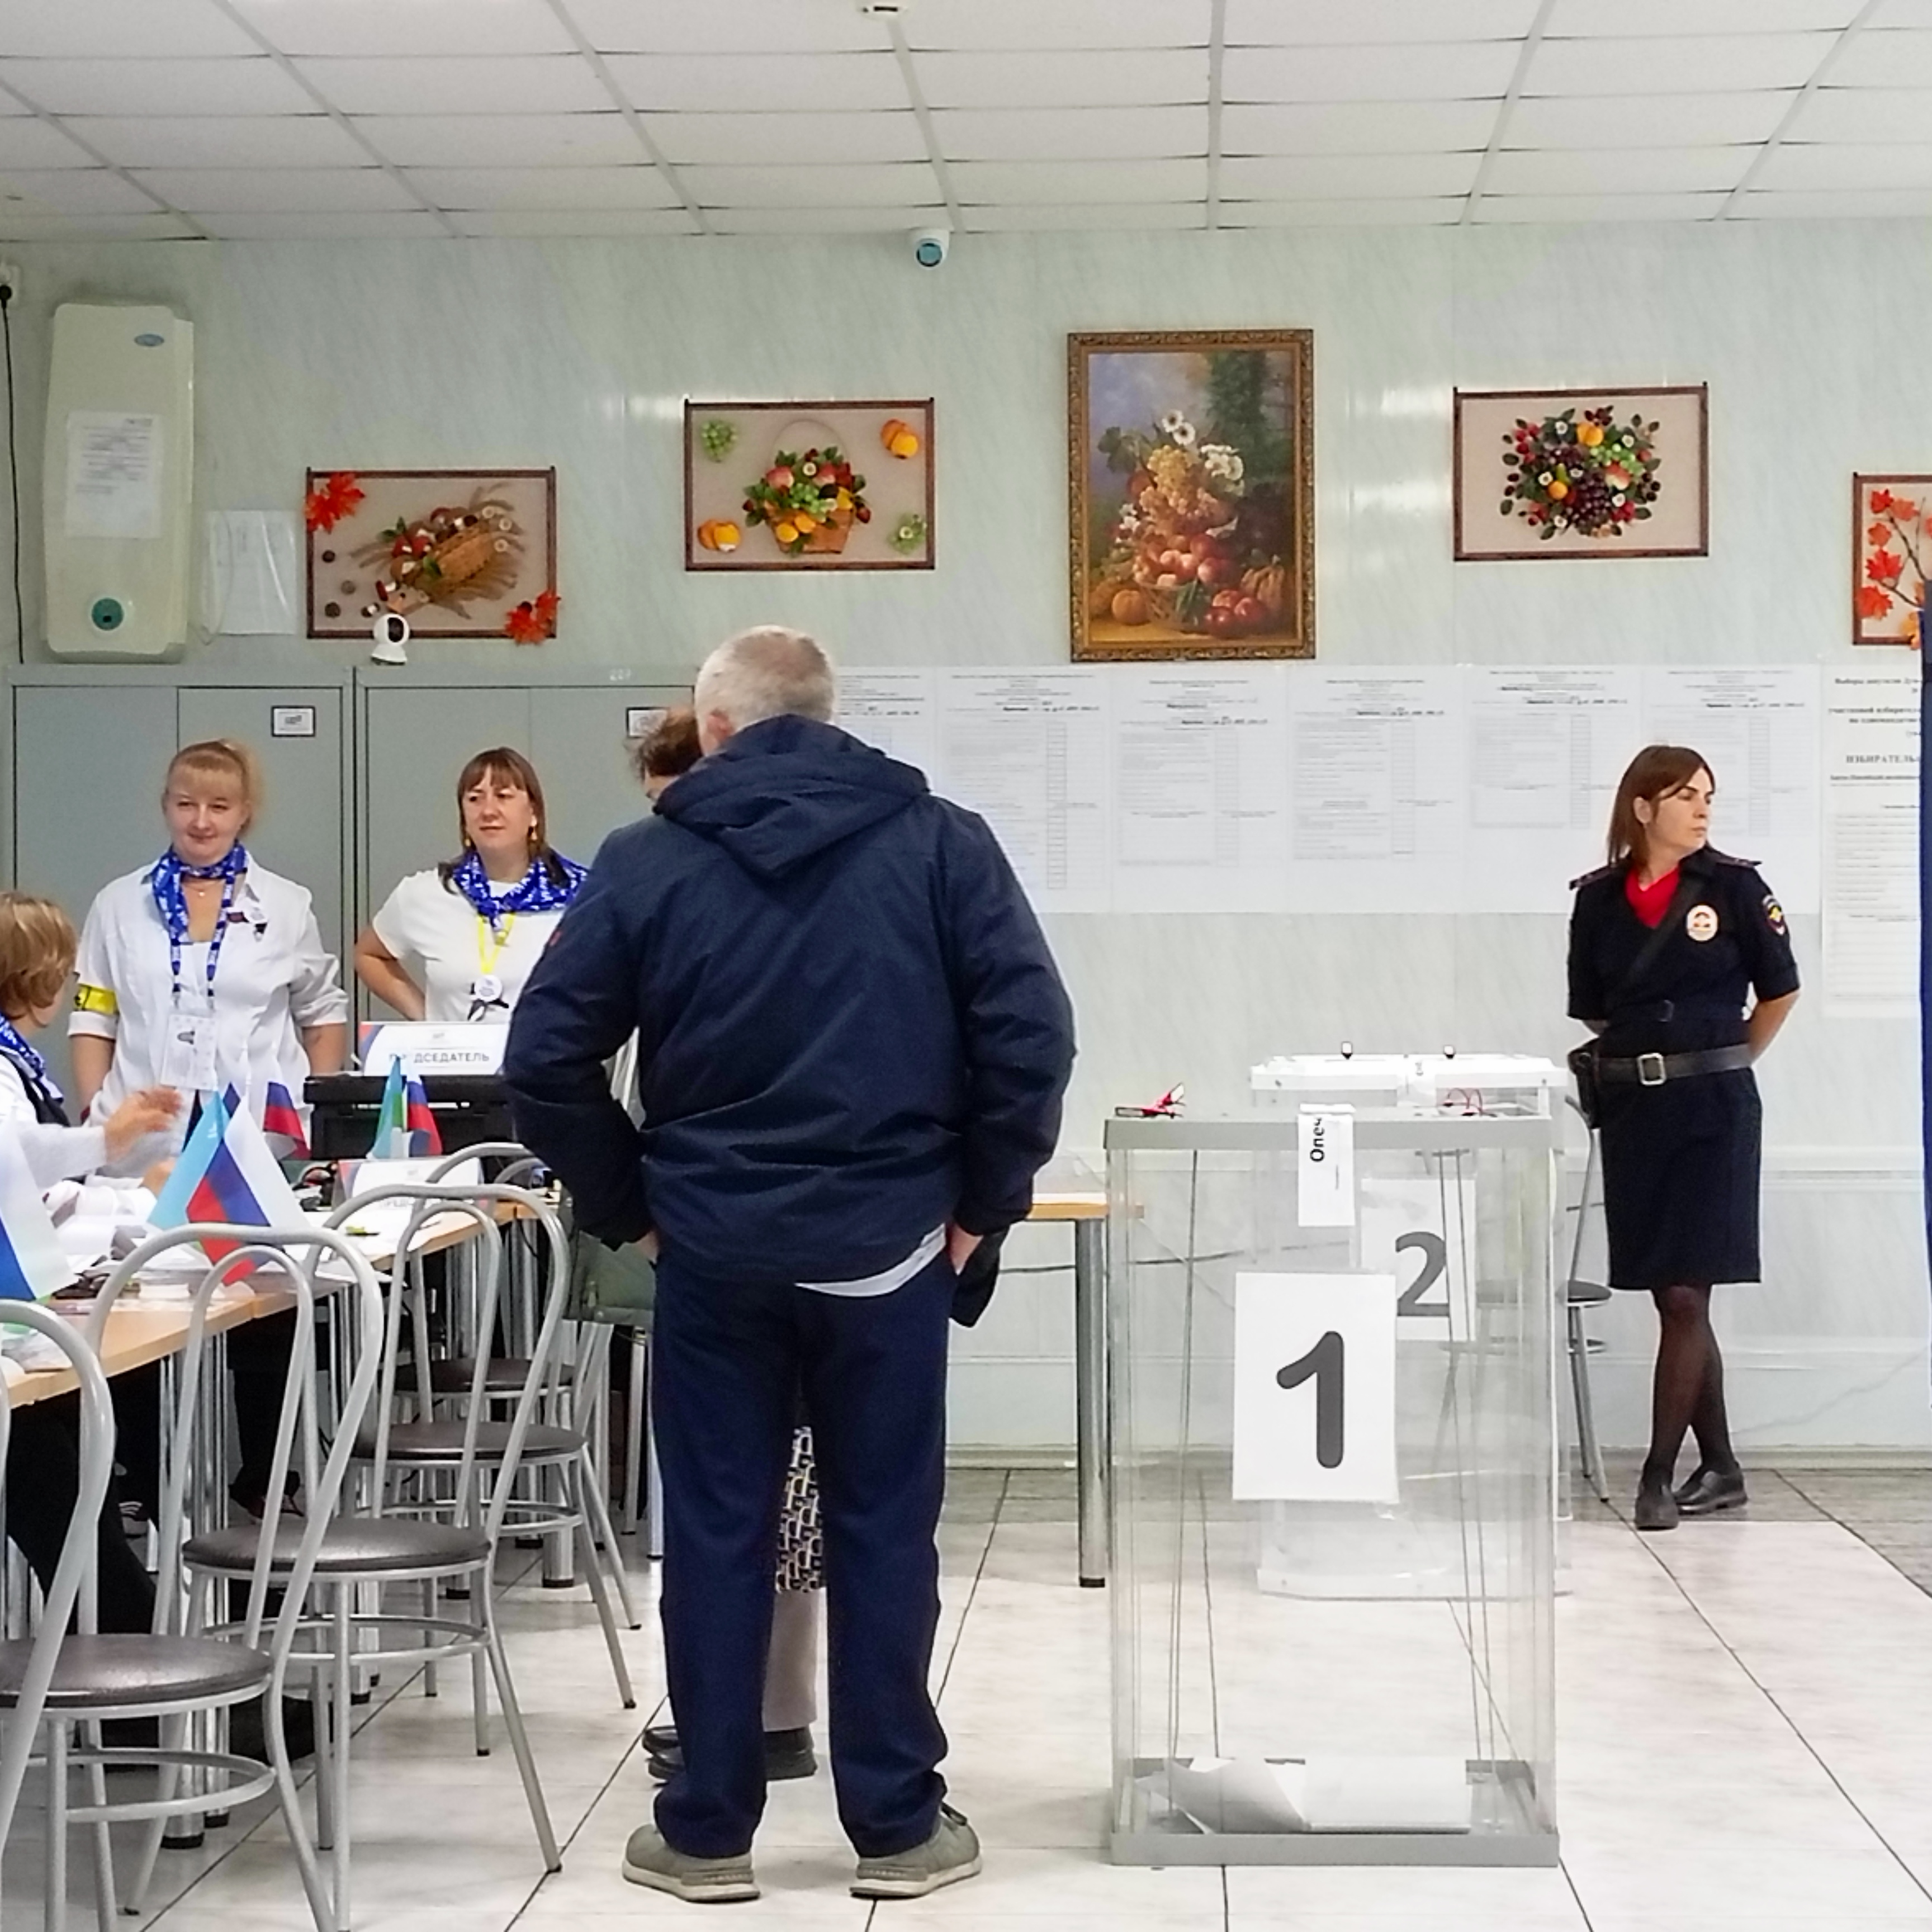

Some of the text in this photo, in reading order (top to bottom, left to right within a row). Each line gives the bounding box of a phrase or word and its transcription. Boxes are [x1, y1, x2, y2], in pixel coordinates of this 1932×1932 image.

[1846, 755, 1920, 764] ИЗБИРАТЕЛЬ
[1395, 1231, 1450, 1317] 2
[1276, 1330, 1344, 1469] 1
